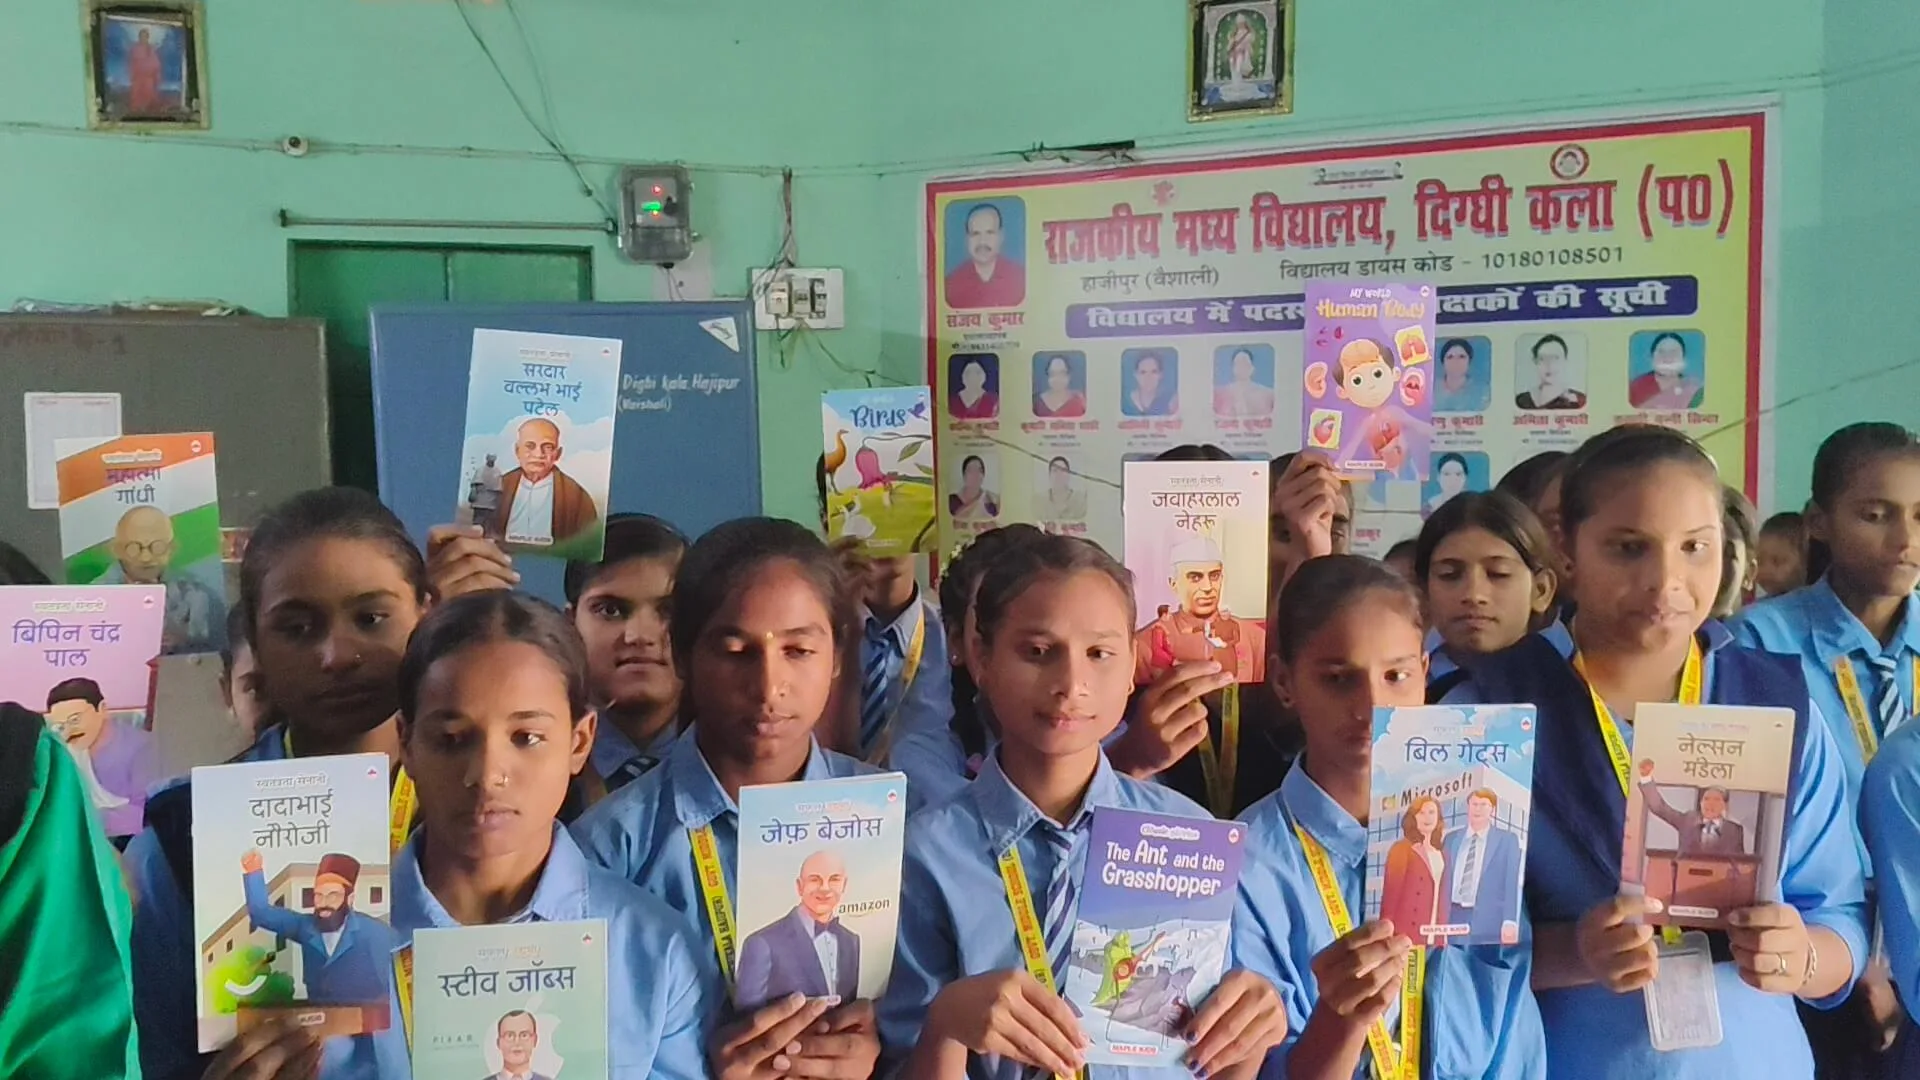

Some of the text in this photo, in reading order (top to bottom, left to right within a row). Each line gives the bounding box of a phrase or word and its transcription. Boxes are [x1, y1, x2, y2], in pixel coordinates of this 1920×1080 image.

[1042, 202, 1163, 264] राजकीय
[1173, 207, 1240, 256] मध्य
[1525, 180, 1617, 234] कला
[1280, 260, 1349, 279] विद्यालय
[1357, 257, 1405, 277] डायस
[1413, 252, 1453, 273] कोड
[1481, 247, 1623, 270] 10180108501
[1081, 265, 1219, 295] हाजीपुर (वैशाली)
[1086, 303, 1196, 329] विद्यालय
[1206, 299, 1234, 323] में
[1535, 283, 1586, 309] की
[1599, 281, 1670, 314] सूची
[1316, 298, 1378, 320] Human
[988, 311, 1025, 331] कुमार
[522, 362, 567, 380] सरदार
[504, 379, 583, 403] वल्लभ भाई
[523, 400, 560, 417] पटेल
[849, 405, 906, 428] Birds
[106, 466, 161, 485] महात्मा
[116, 484, 156, 505] गांधी
[1151, 491, 1241, 509] जवाहरलाल
[1174, 509, 1217, 532] नेहरू
[13, 619, 122, 643] बिपिन चंद्र
[43, 648, 91, 668] पाल
[1405, 737, 1509, 768] बिल गेट्स
[1677, 733, 1745, 757] नेल्सन
[1683, 757, 1735, 780] मंडेला
[1401, 772, 1472, 808] Microsoft
[249, 788, 333, 818] दादाभाई
[253, 820, 330, 848] नौरोजी
[760, 813, 883, 844] जेफ़ बेजोस
[1106, 840, 1225, 872] The Ant and the
[1102, 862, 1221, 898] Grasshopper
[838, 898, 890, 914] amazon
[438, 960, 576, 998] स्टीव जॉब्स
